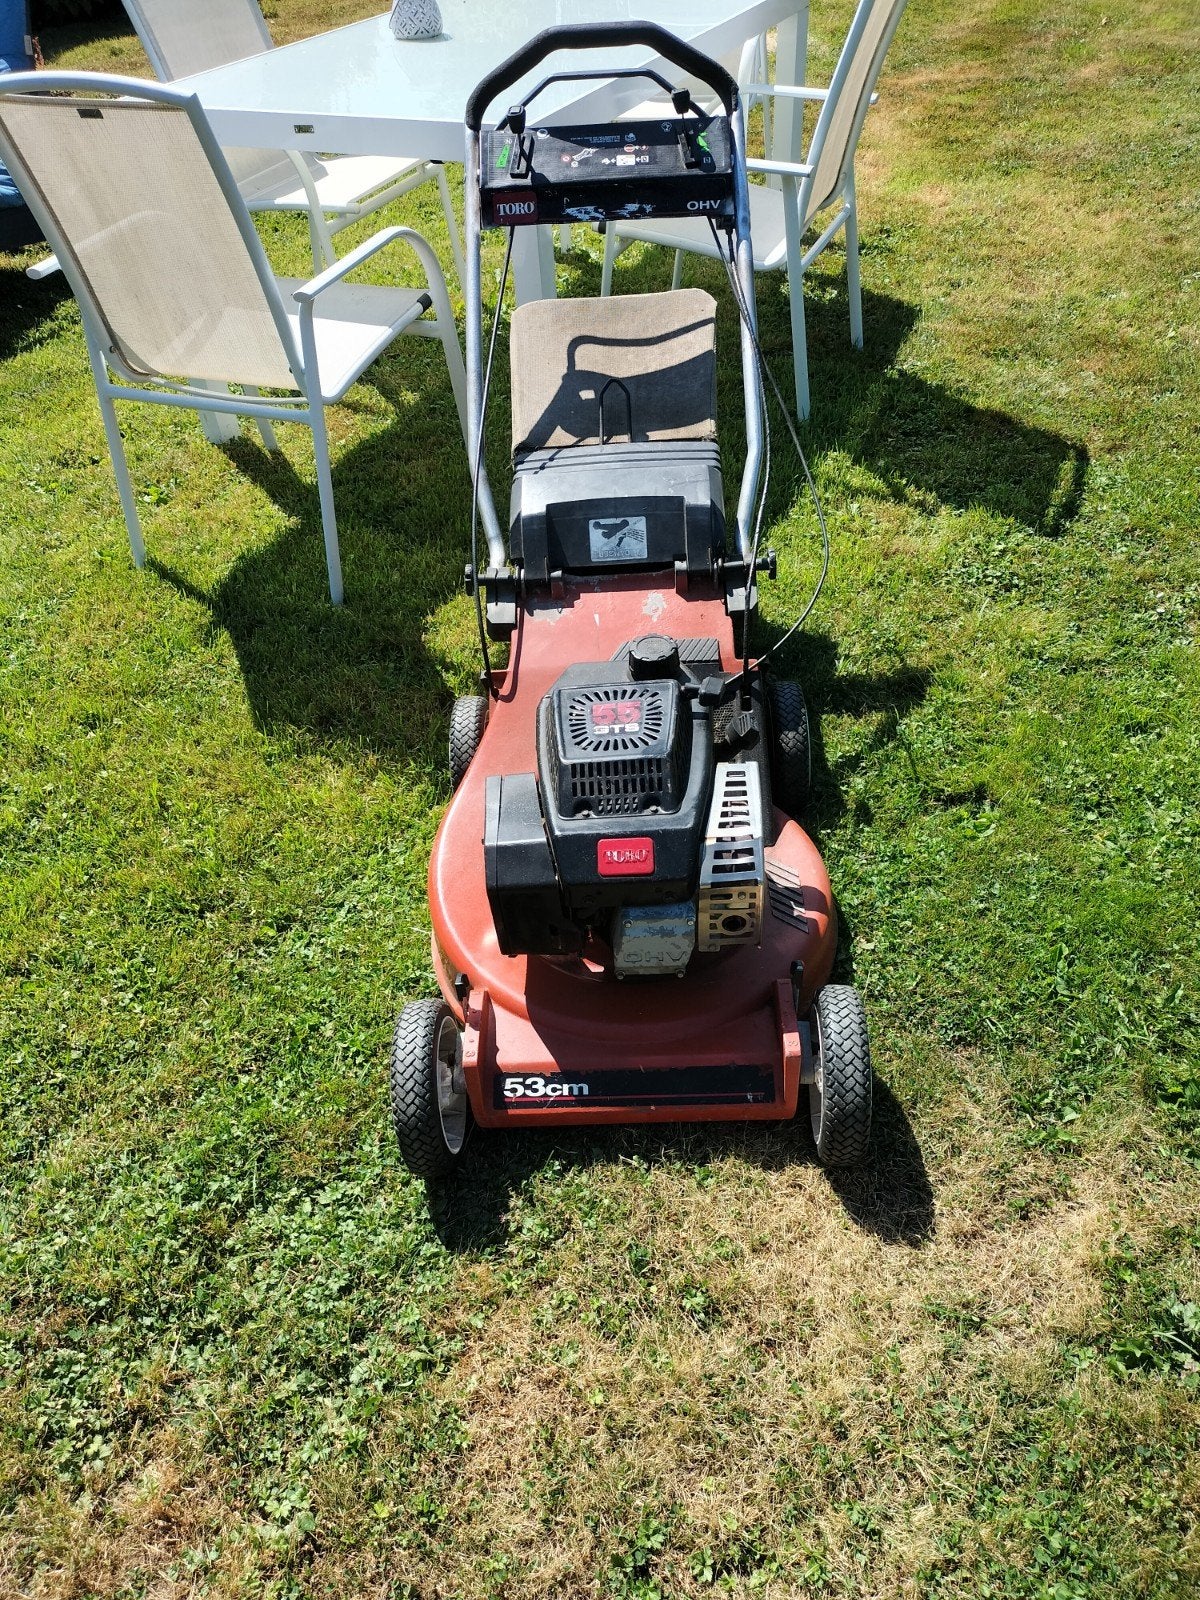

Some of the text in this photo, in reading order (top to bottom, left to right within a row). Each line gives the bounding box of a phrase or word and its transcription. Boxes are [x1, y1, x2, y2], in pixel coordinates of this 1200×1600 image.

[497, 201, 535, 216] TORO
[686, 200, 721, 211] OHV
[503, 1077, 588, 1097] 53cm
